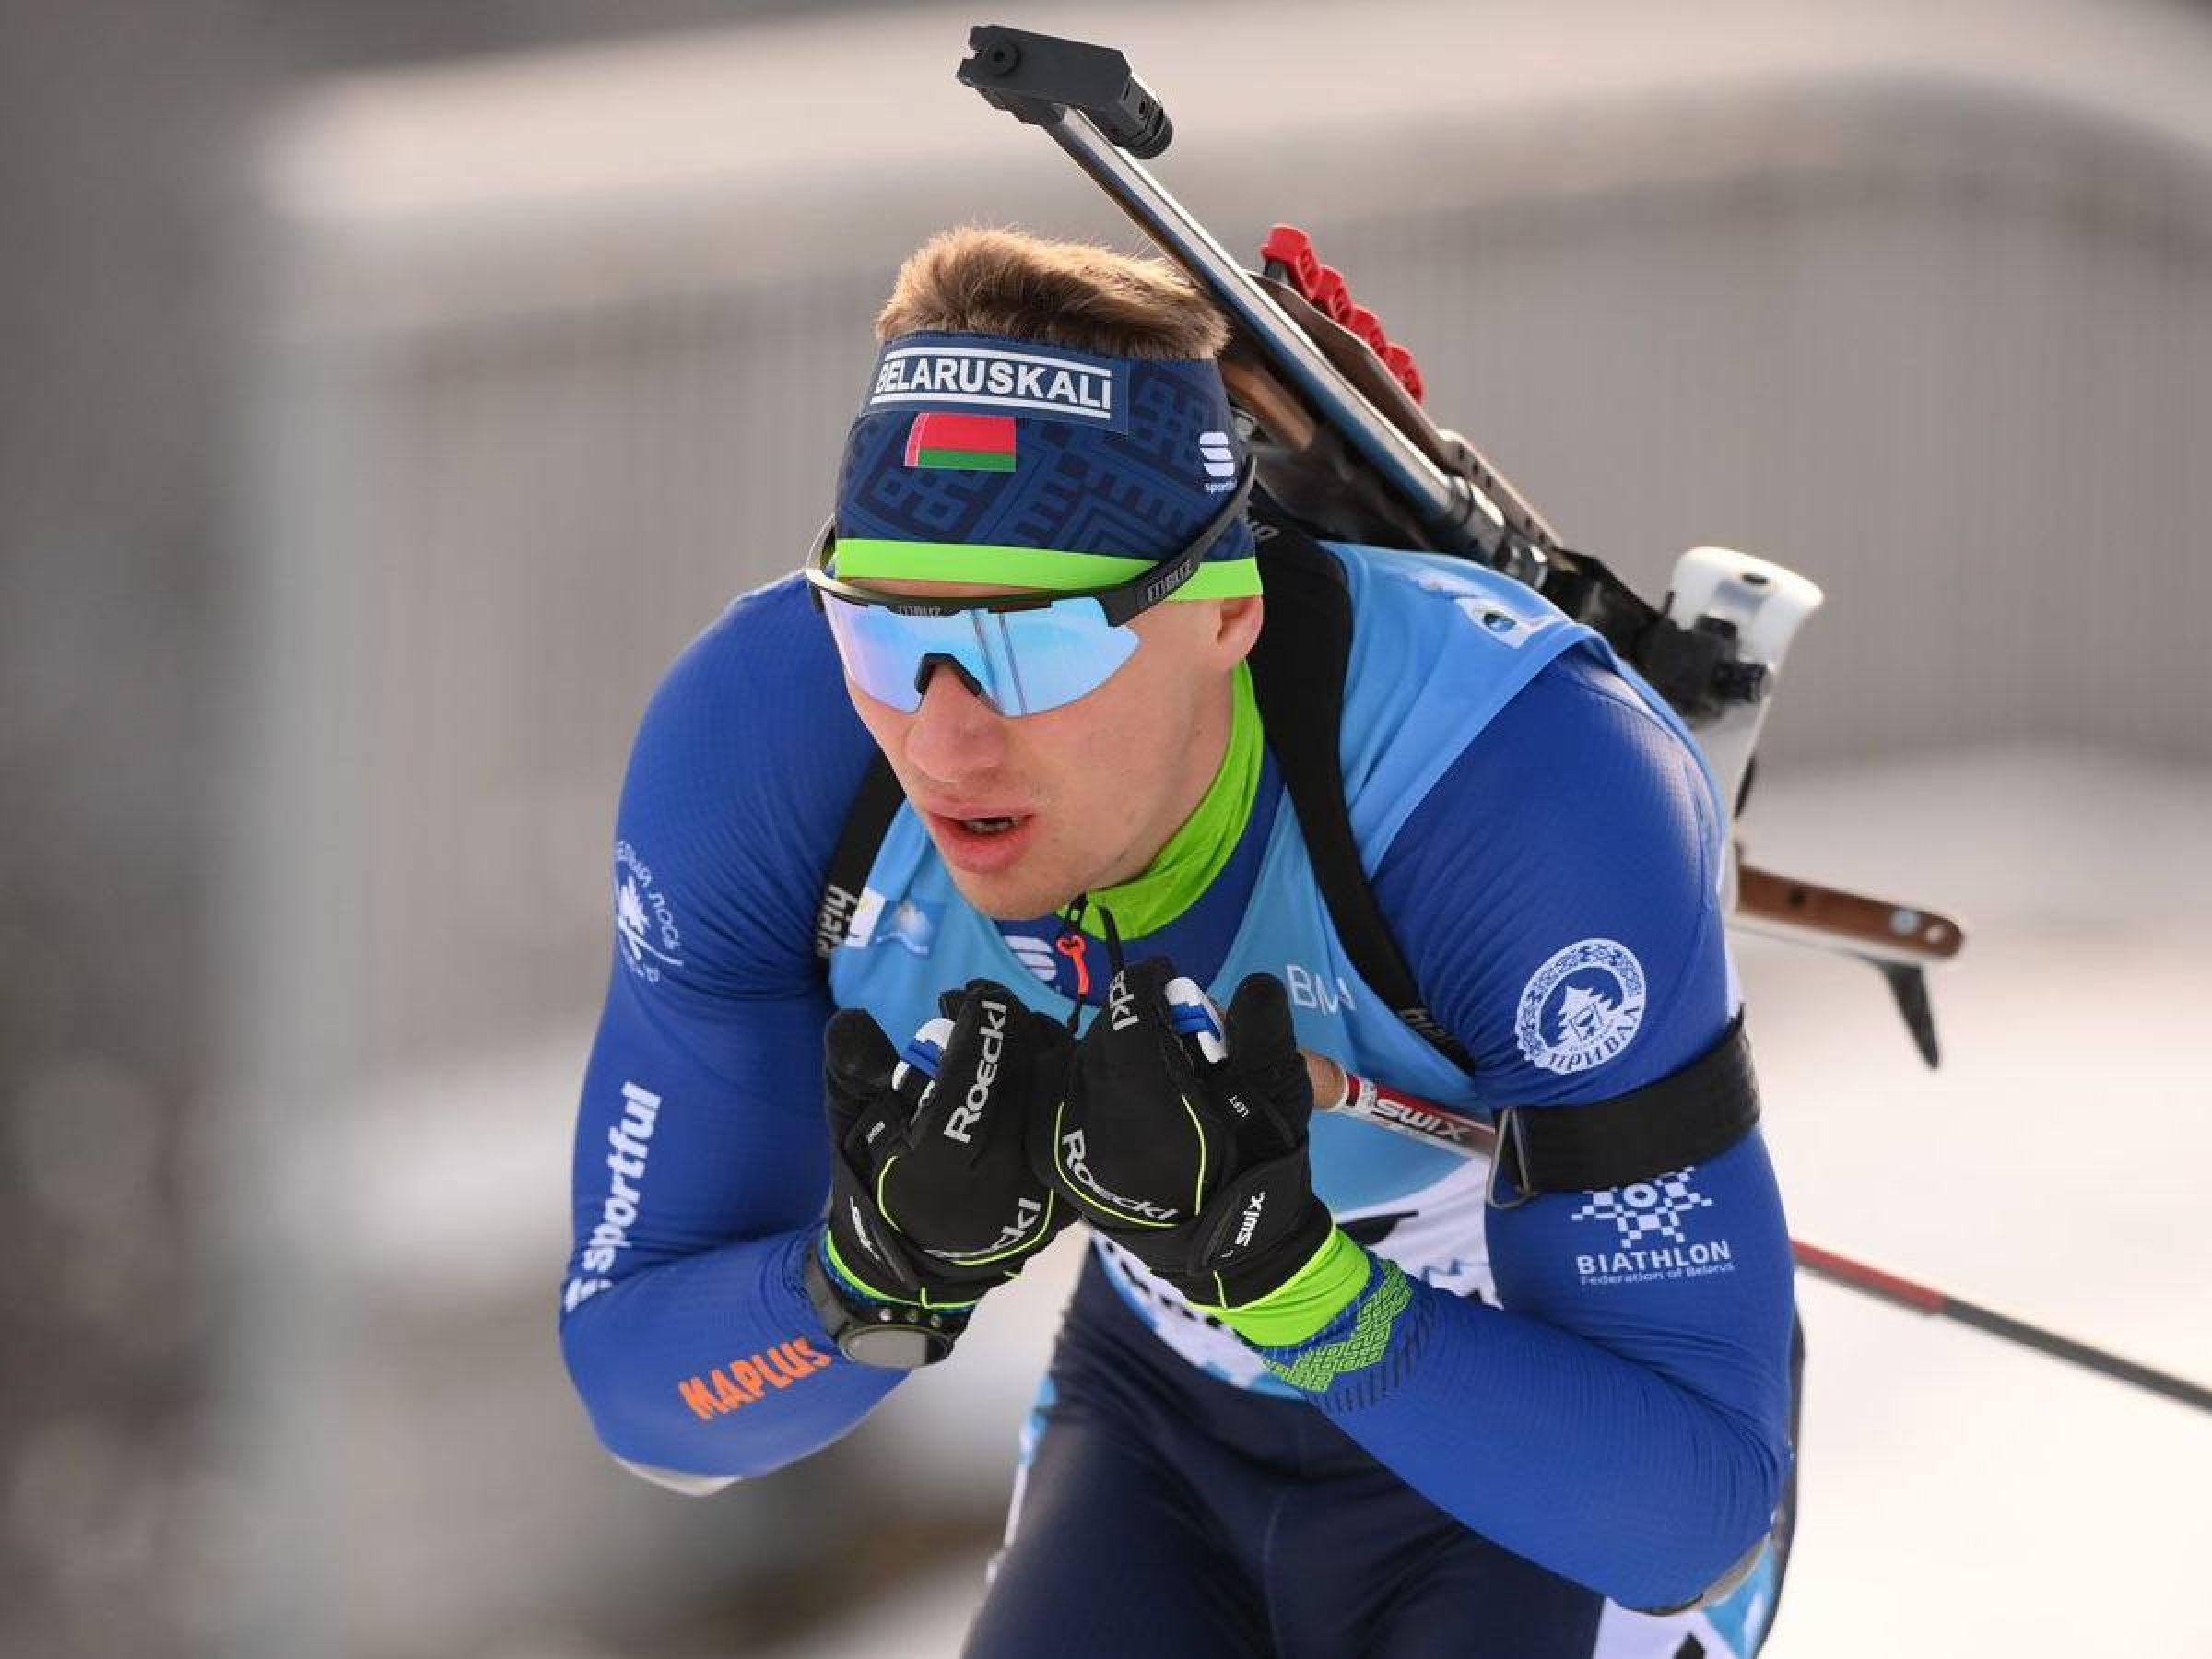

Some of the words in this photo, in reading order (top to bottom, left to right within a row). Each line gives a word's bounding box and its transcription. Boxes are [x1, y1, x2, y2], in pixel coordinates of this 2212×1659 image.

[875, 358, 1112, 410] BELARUSKALI
[943, 1000, 1007, 1143] Roeckl
[582, 1080, 663, 1274] sportful
[1576, 1239, 1732, 1276] BIATHLON
[677, 1337, 833, 1421] MAPLUS
